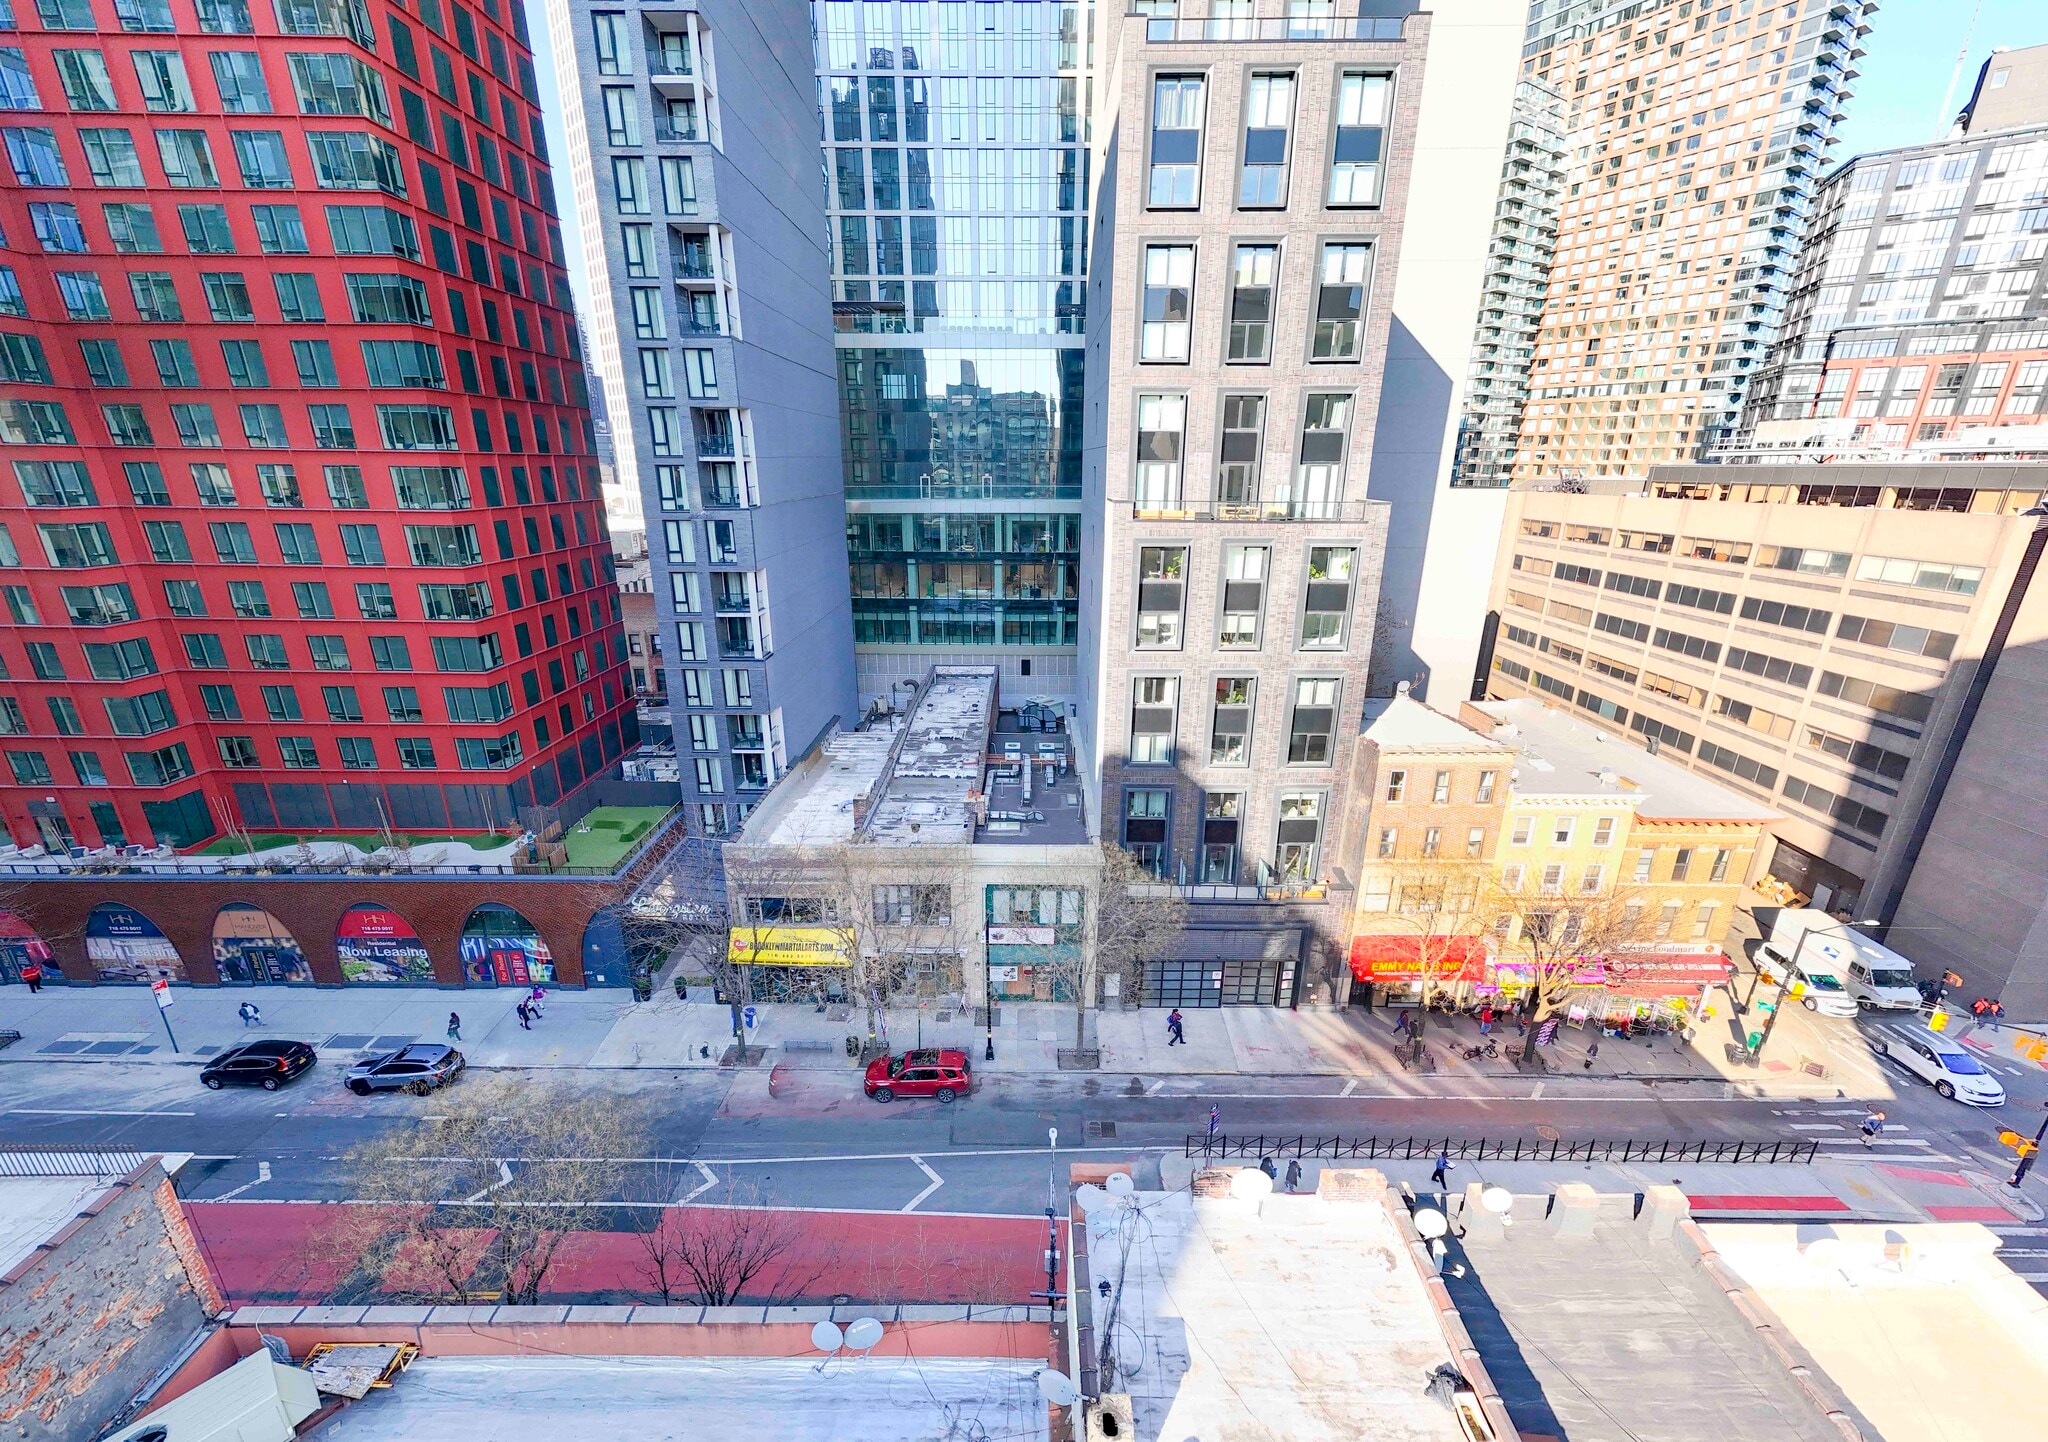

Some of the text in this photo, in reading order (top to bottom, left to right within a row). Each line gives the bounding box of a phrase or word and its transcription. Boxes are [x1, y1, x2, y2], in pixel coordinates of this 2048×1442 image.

[90, 946, 180, 959] Now Leasing
[340, 946, 429, 959] Now Leasing
[1371, 961, 1462, 971] EMMY NALS INC
